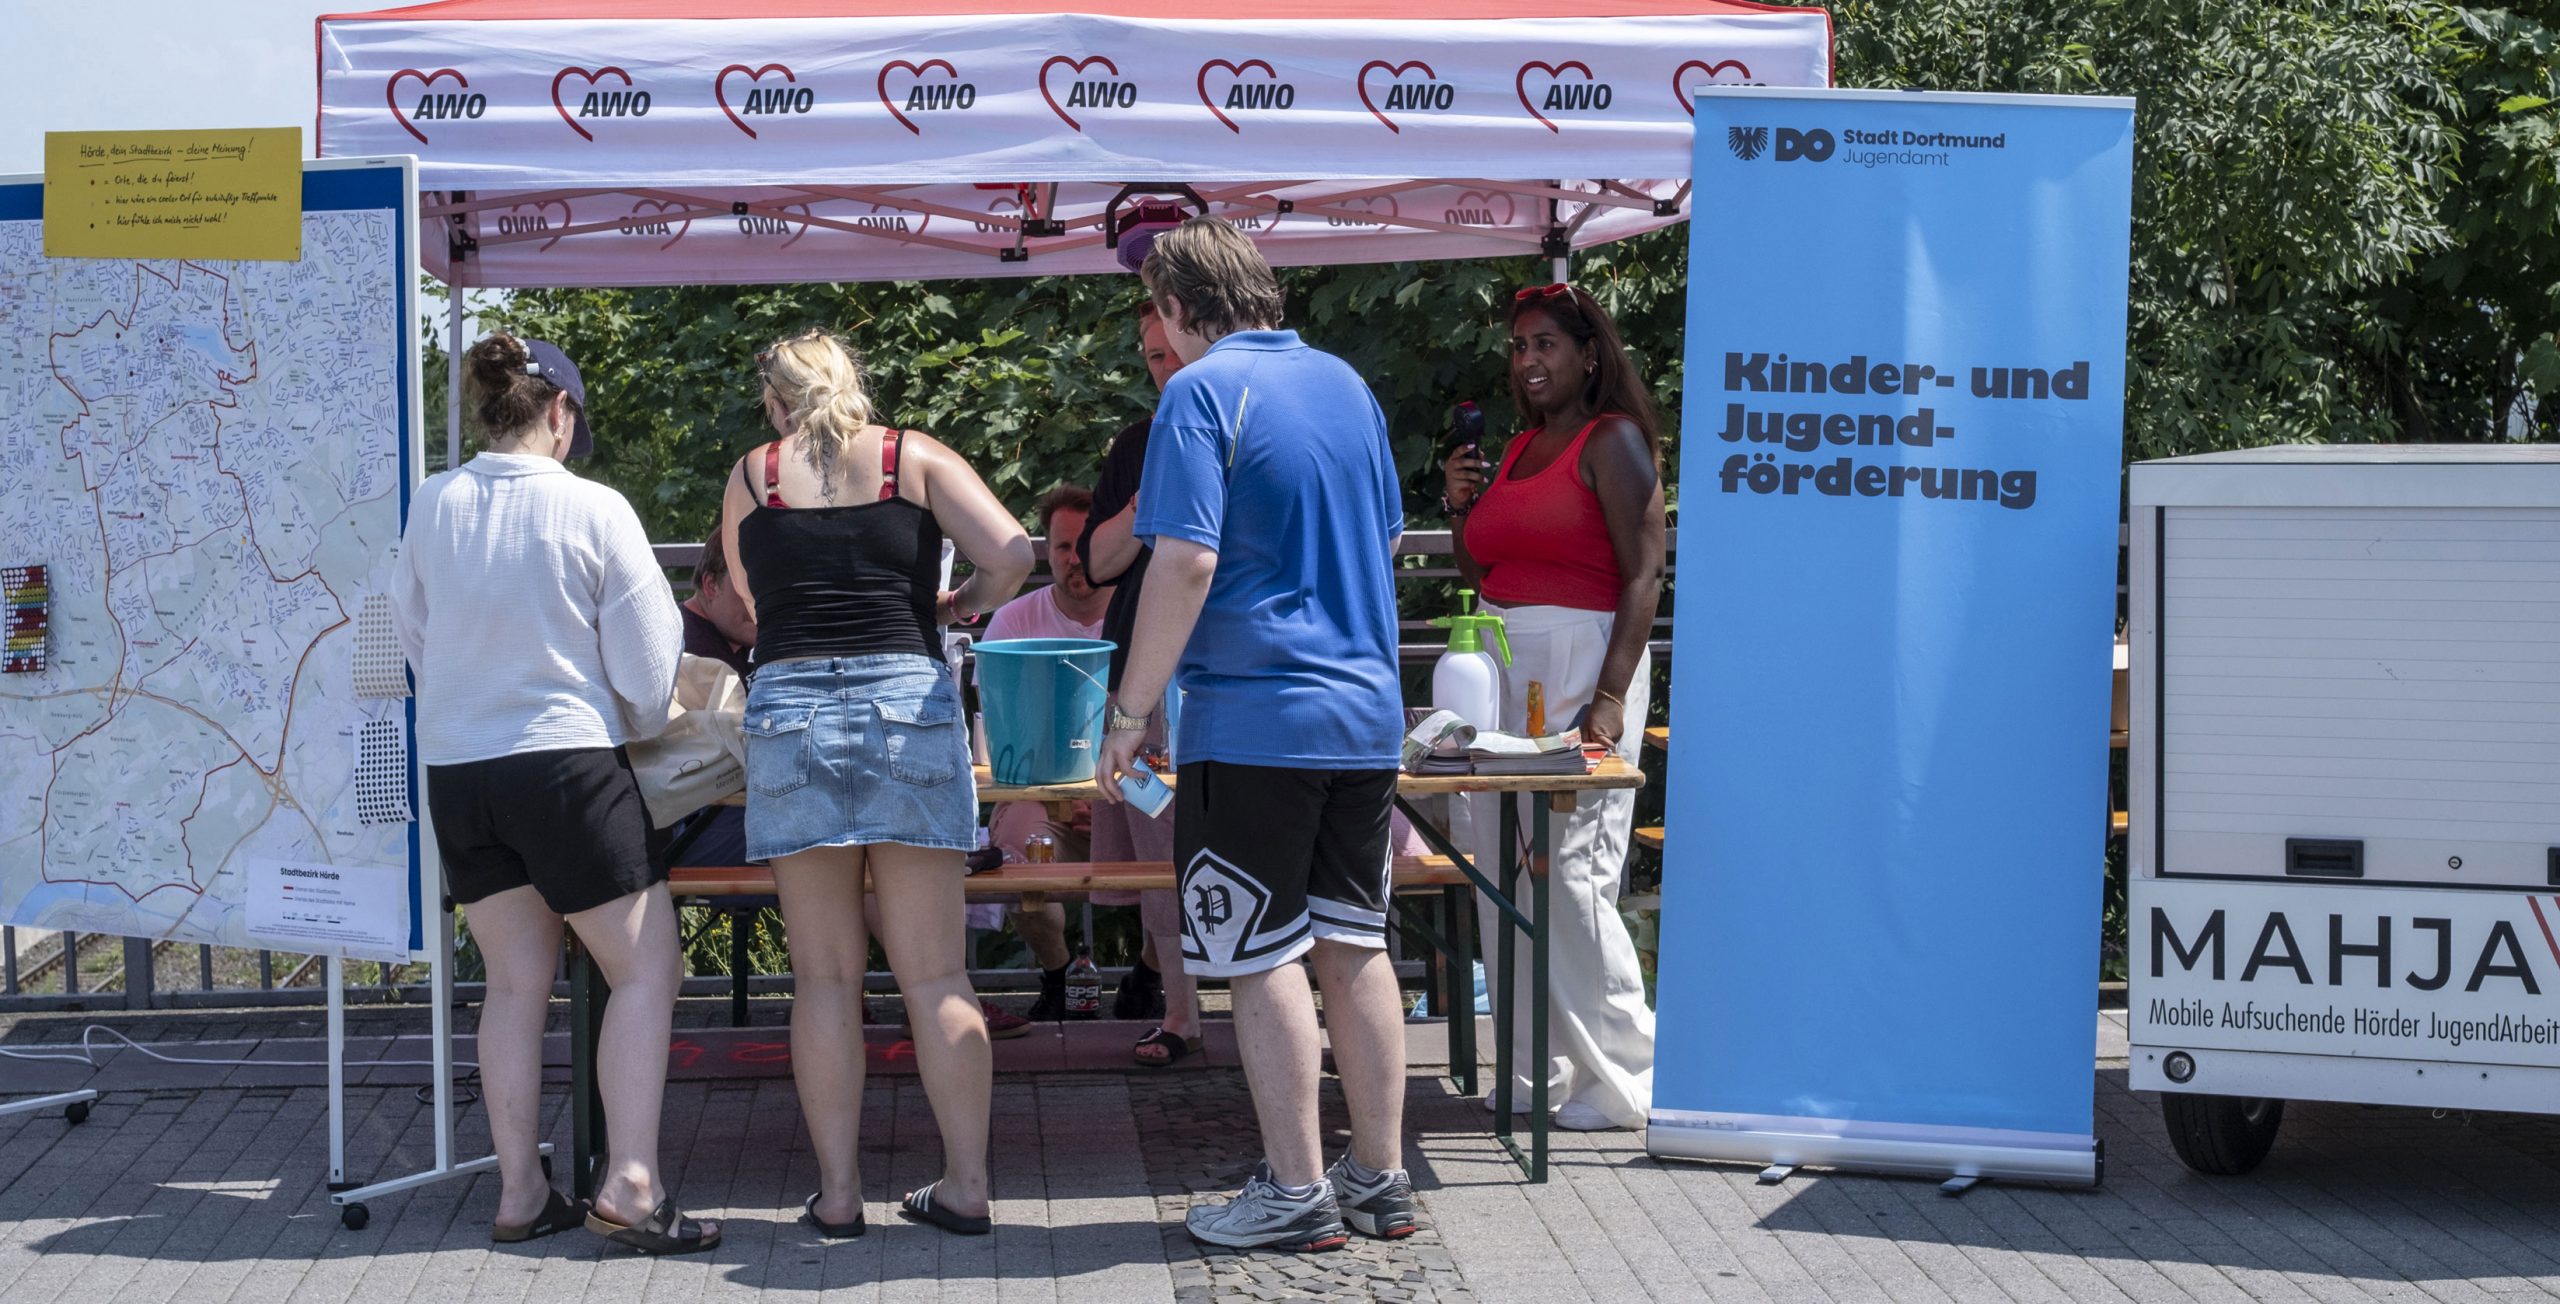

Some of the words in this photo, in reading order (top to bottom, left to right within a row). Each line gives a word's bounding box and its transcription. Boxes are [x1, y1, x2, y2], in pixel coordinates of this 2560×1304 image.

[413, 93, 486, 120] AWO
[579, 91, 652, 117] AWO
[742, 87, 814, 115] AWO
[905, 83, 976, 111] AWO
[1066, 81, 1137, 108] AWO
[1225, 83, 1295, 110] AWO
[1385, 83, 1454, 111] AWO
[1543, 83, 1612, 111] AWO
[1775, 127, 1836, 162] DO
[1843, 129, 1898, 146] Stadt
[1902, 131, 2005, 149] Dortmund
[1842, 148, 1950, 169] Jugendamt
[1724, 352, 1955, 395] Kinder-
[1971, 361, 2090, 400] und
[1717, 403, 1955, 452] Jugend-
[1719, 453, 2037, 510] förderung
[280, 867, 319, 879] Stadtbezirk
[319, 871, 340, 881] Hörde
[2149, 998, 2214, 1028] Mobile
[2221, 1002, 2346, 1034] Aufsuchende
[2354, 1009, 2420, 1037] Hörder
[2427, 1012, 2560, 1047] JugendArbeit
